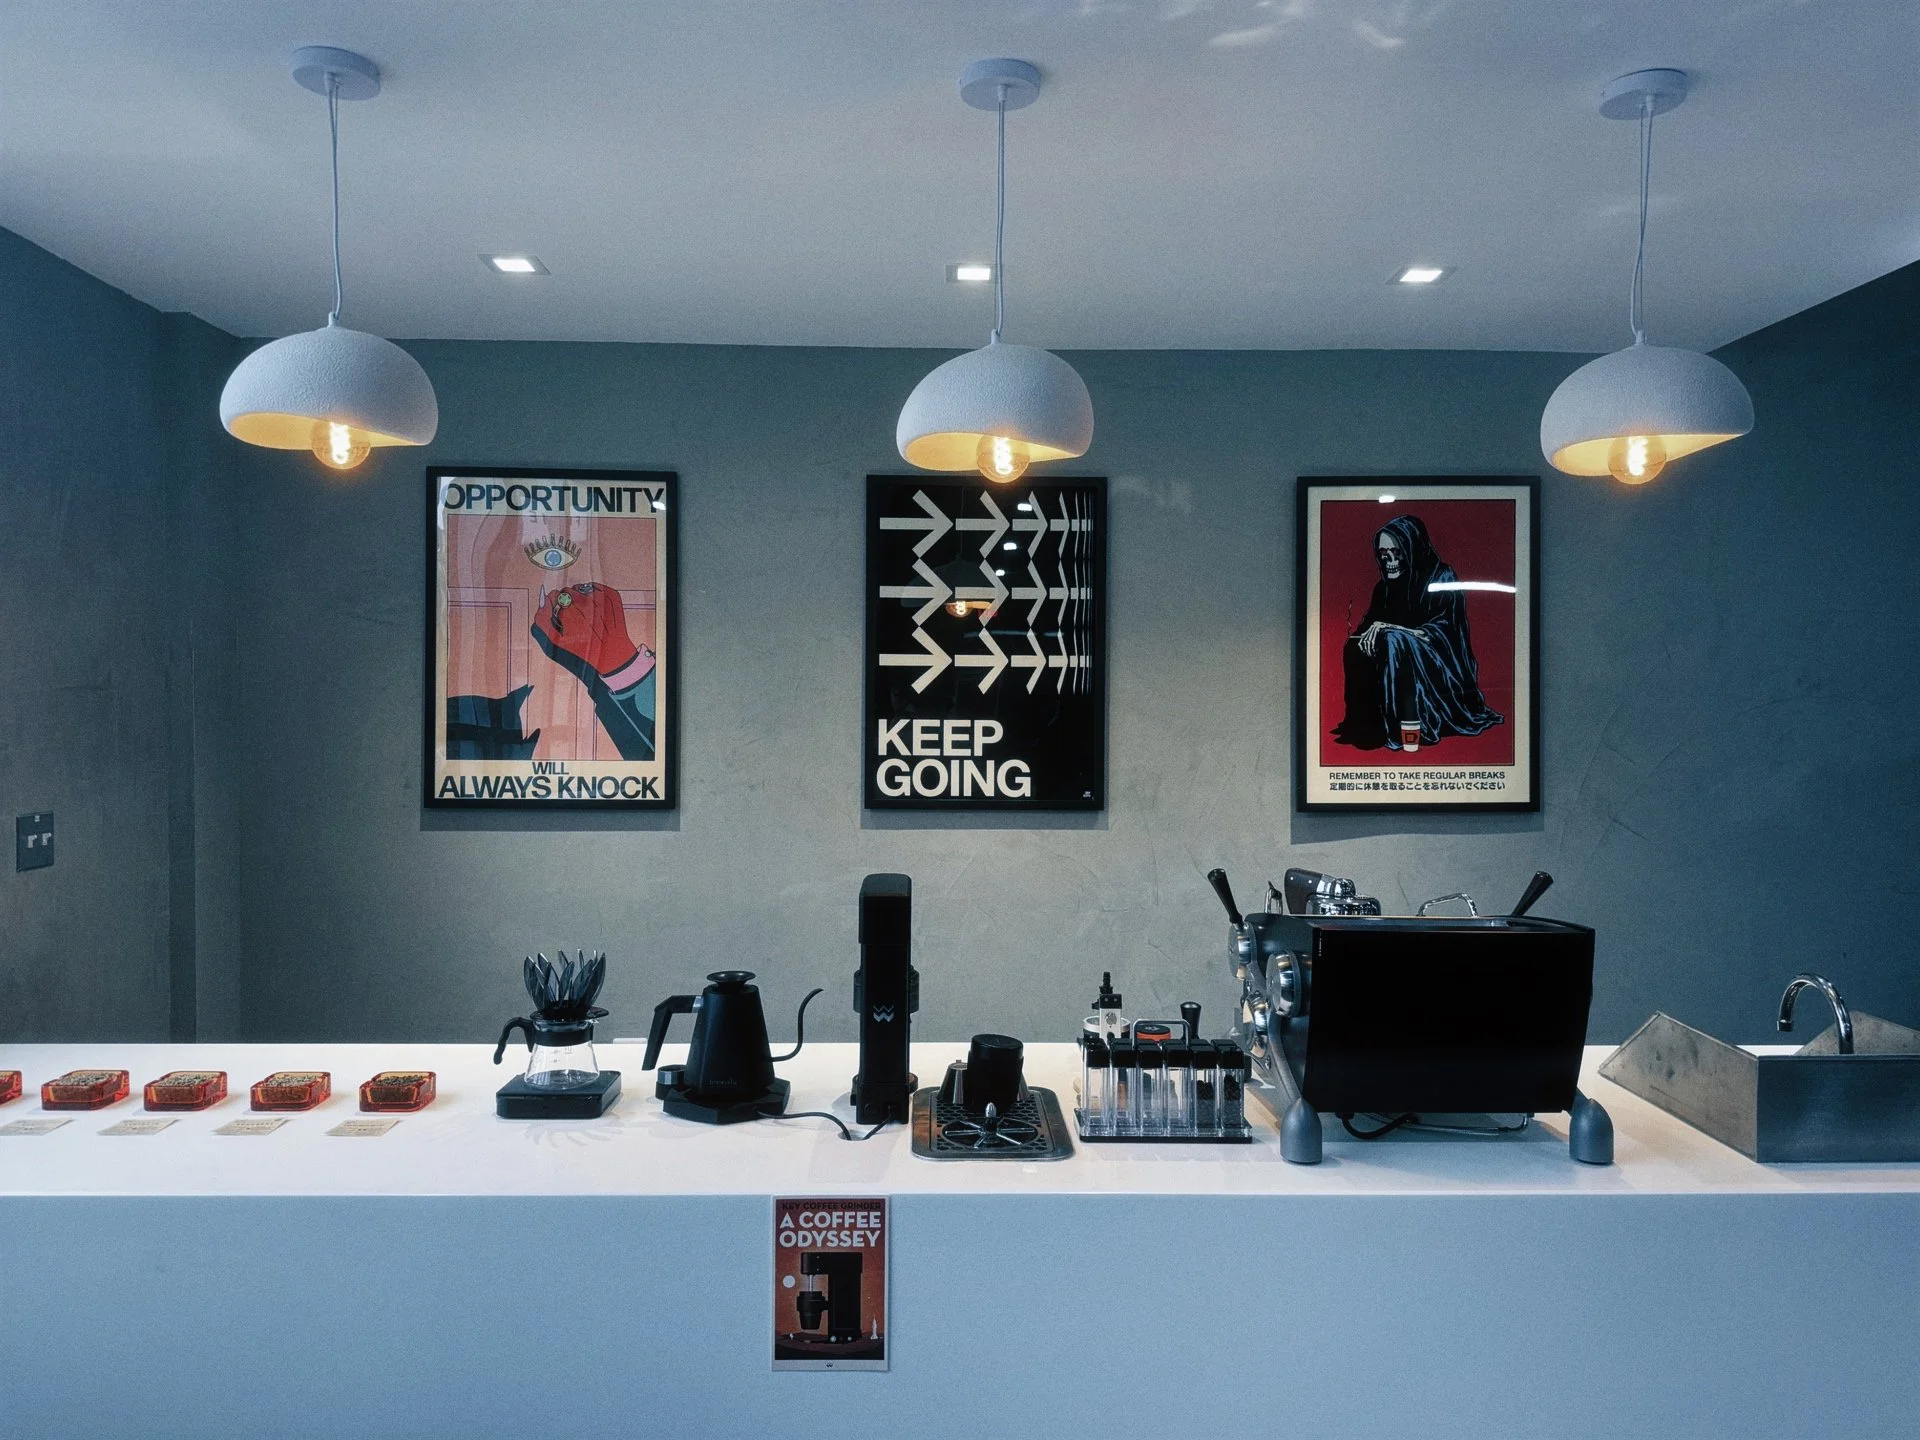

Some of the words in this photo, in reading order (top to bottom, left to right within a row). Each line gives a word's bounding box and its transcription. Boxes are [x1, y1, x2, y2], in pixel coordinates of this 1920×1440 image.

[444, 484, 664, 513] OPPORTUNITY
[878, 718, 1004, 756] KEEP
[532, 761, 569, 775] WILL
[1329, 772, 1381, 780] REMEMBER
[1383, 772, 1396, 780] TO
[1399, 772, 1421, 780] TAKE
[1423, 772, 1466, 780] REGULAR
[1468, 771, 1506, 780] BREAKS
[876, 758, 1031, 797] GOING
[438, 775, 551, 798] ALWAYS
[558, 776, 661, 799] KNOCK
[782, 1202, 799, 1210] KEY
[803, 1202, 839, 1210] COFFEE
[841, 1202, 881, 1210] GRINDER
[779, 1212, 795, 1228] A
[799, 1211, 881, 1228] COFFEE
[779, 1230, 881, 1248] ODYSSEY
